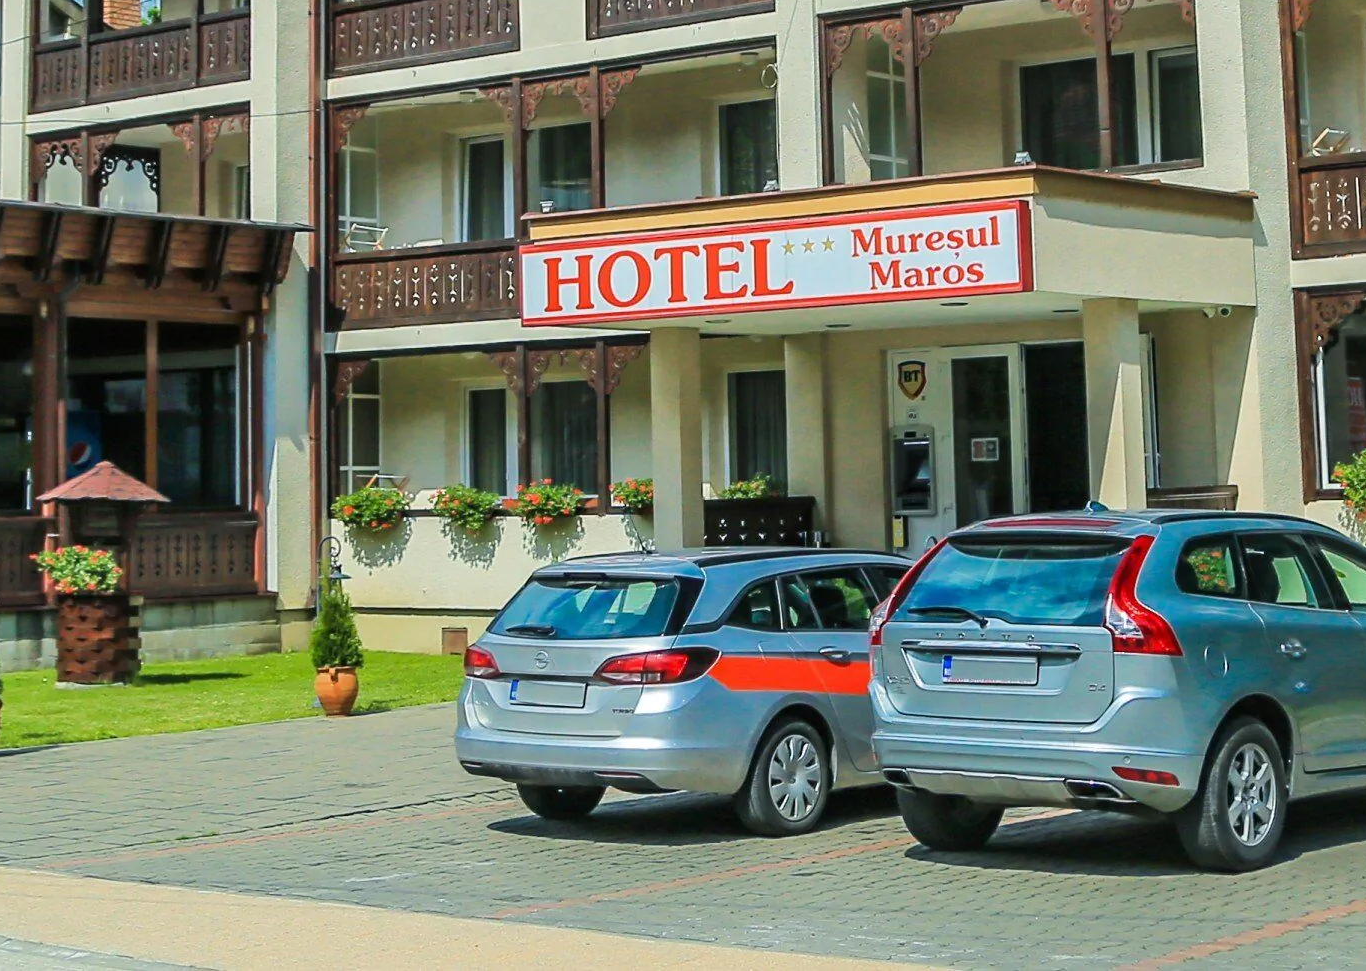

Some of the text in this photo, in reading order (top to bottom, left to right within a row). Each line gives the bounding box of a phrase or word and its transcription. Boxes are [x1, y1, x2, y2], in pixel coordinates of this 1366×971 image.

[542, 238, 794, 313] HOTEL
[869, 260, 984, 290] Maros
[903, 369, 920, 382] BT
